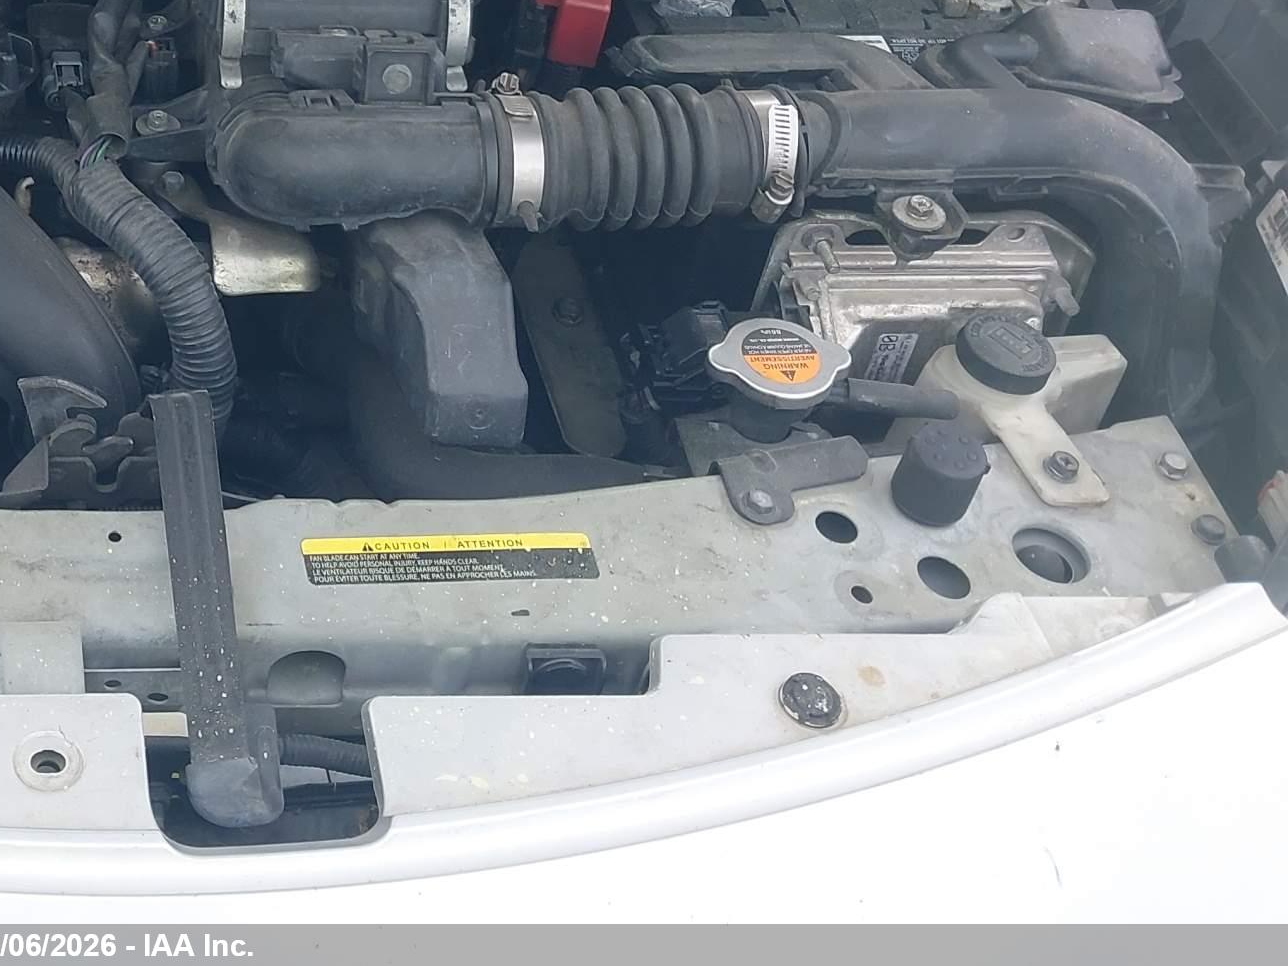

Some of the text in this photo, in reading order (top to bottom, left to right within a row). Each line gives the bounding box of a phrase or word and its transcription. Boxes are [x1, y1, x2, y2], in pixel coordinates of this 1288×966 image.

[749, 355, 815, 363] AVERTISSEMENT
[762, 362, 809, 370] WARNING
[374, 541, 430, 551] CAUTION
[457, 538, 523, 549] ATTENTION
[323, 554, 343, 562] BLADE
[360, 553, 379, 561] START
[322, 561, 337, 569] HELP
[360, 560, 393, 568] PERSONAL
[369, 567, 394, 575] RISQUE
[314, 575, 334, 583] POUR
[360, 574, 383, 582] TOUTE
[420, 572, 431, 580] NE
[432, 572, 445, 580] PAS
[457, 571, 499, 579] APPROCHER
